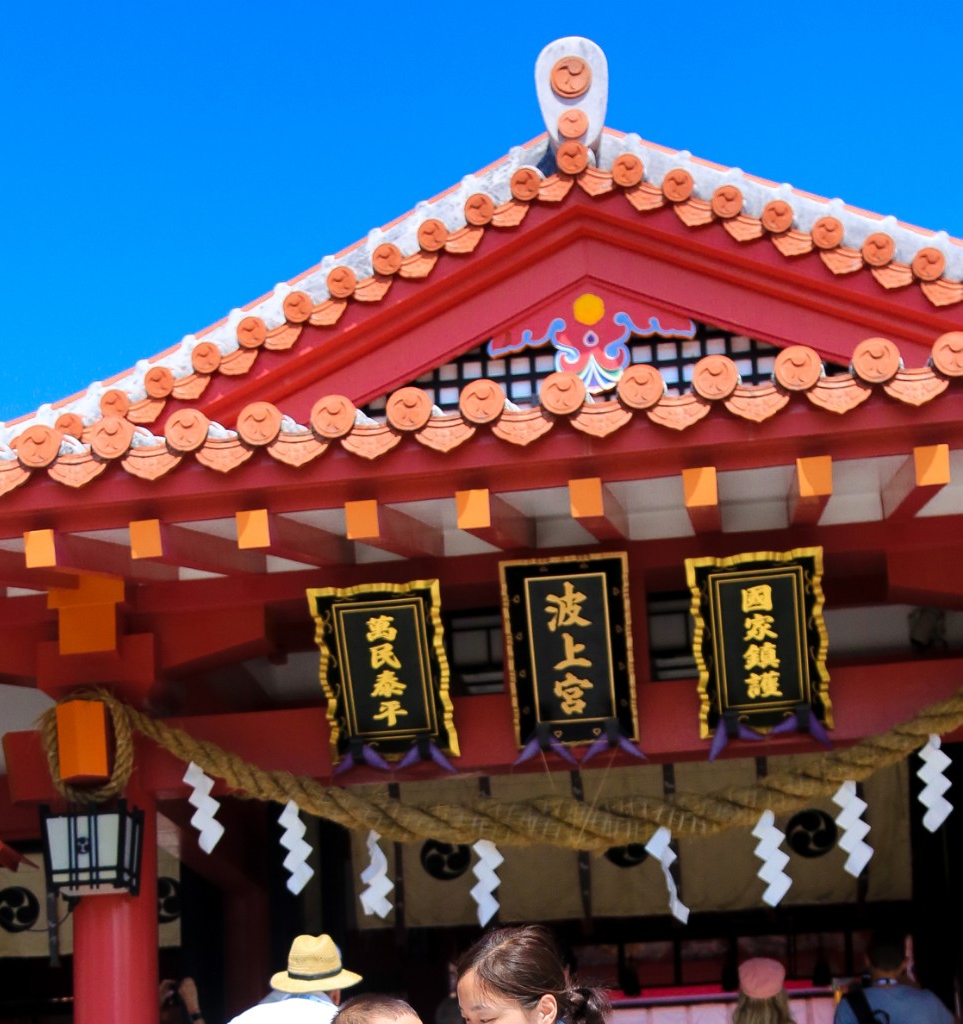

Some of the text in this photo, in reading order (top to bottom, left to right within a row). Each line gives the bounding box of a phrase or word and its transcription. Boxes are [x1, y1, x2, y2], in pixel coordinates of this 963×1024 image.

[365, 614, 409, 727] 萬民泰平
[545, 581, 593, 716] 波上宮
